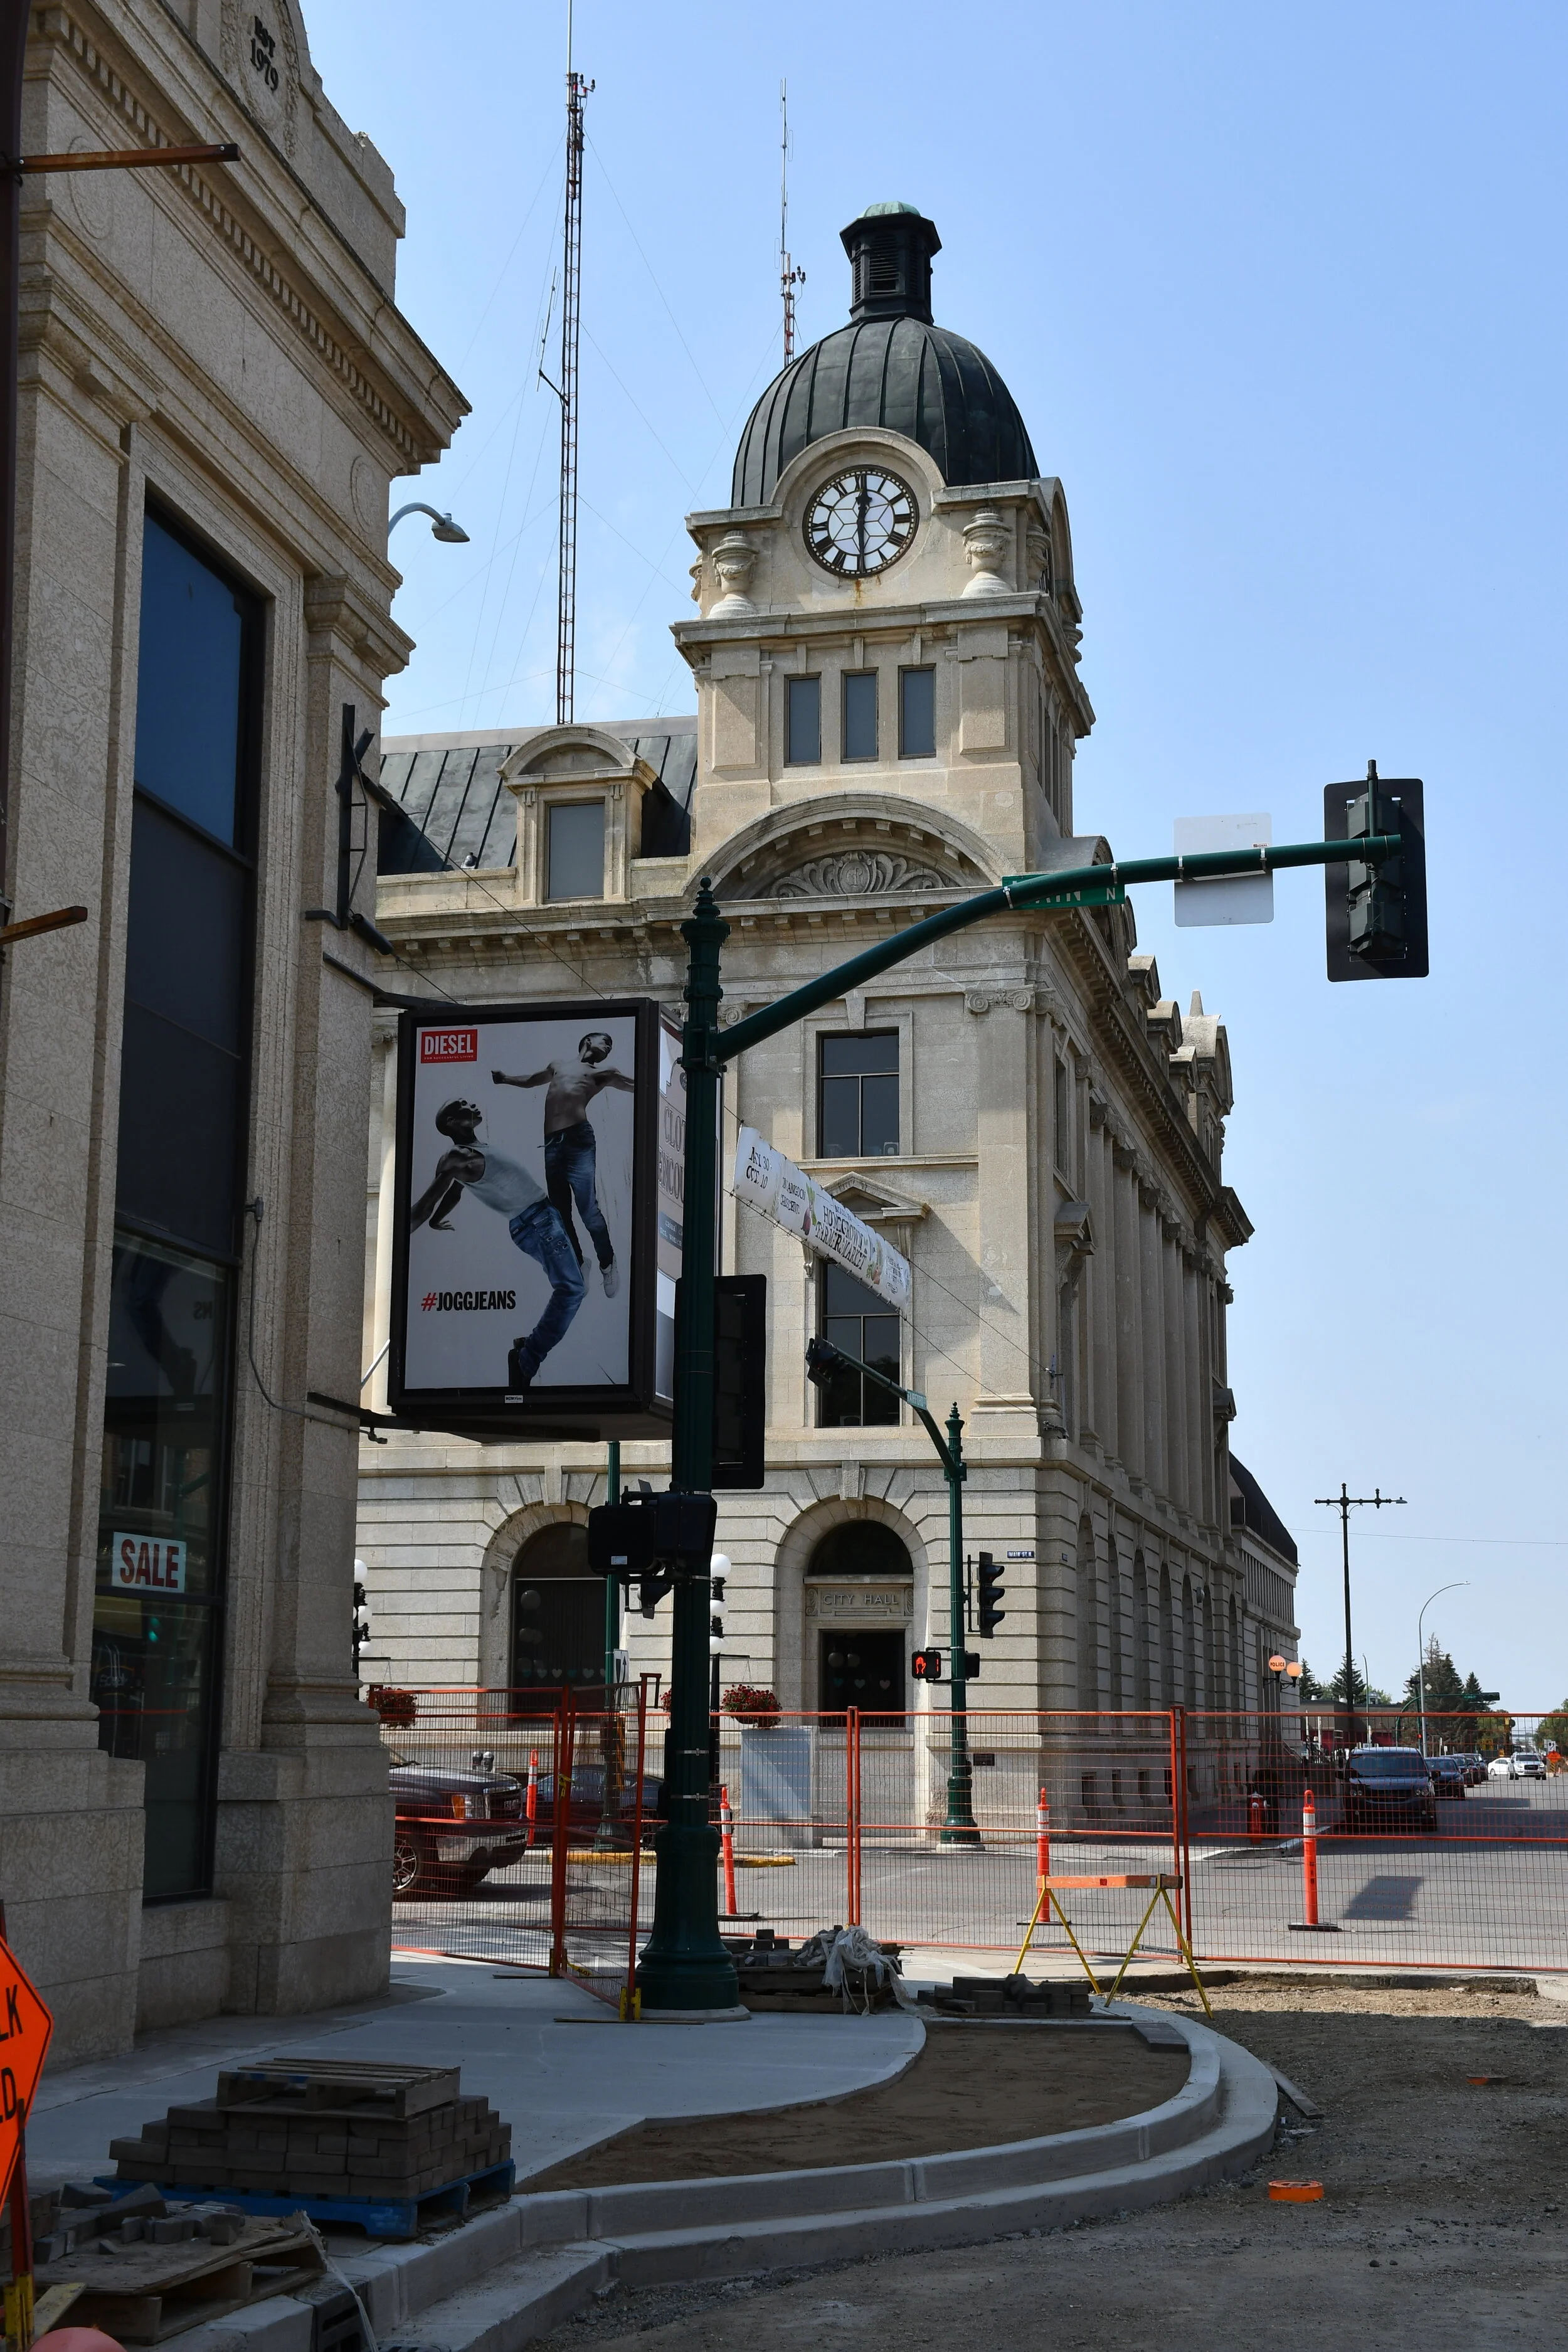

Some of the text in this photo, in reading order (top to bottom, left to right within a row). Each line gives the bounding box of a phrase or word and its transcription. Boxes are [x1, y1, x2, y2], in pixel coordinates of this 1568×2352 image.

[250, 36, 279, 91] 1979
[1106, 887, 1116, 901] N
[425, 1034, 474, 1055] DIESEL
[421, 1290, 516, 1312] #JOGGJEANS
[120, 1539, 179, 1588] SALE
[823, 1594, 898, 1605] CITY HALL
